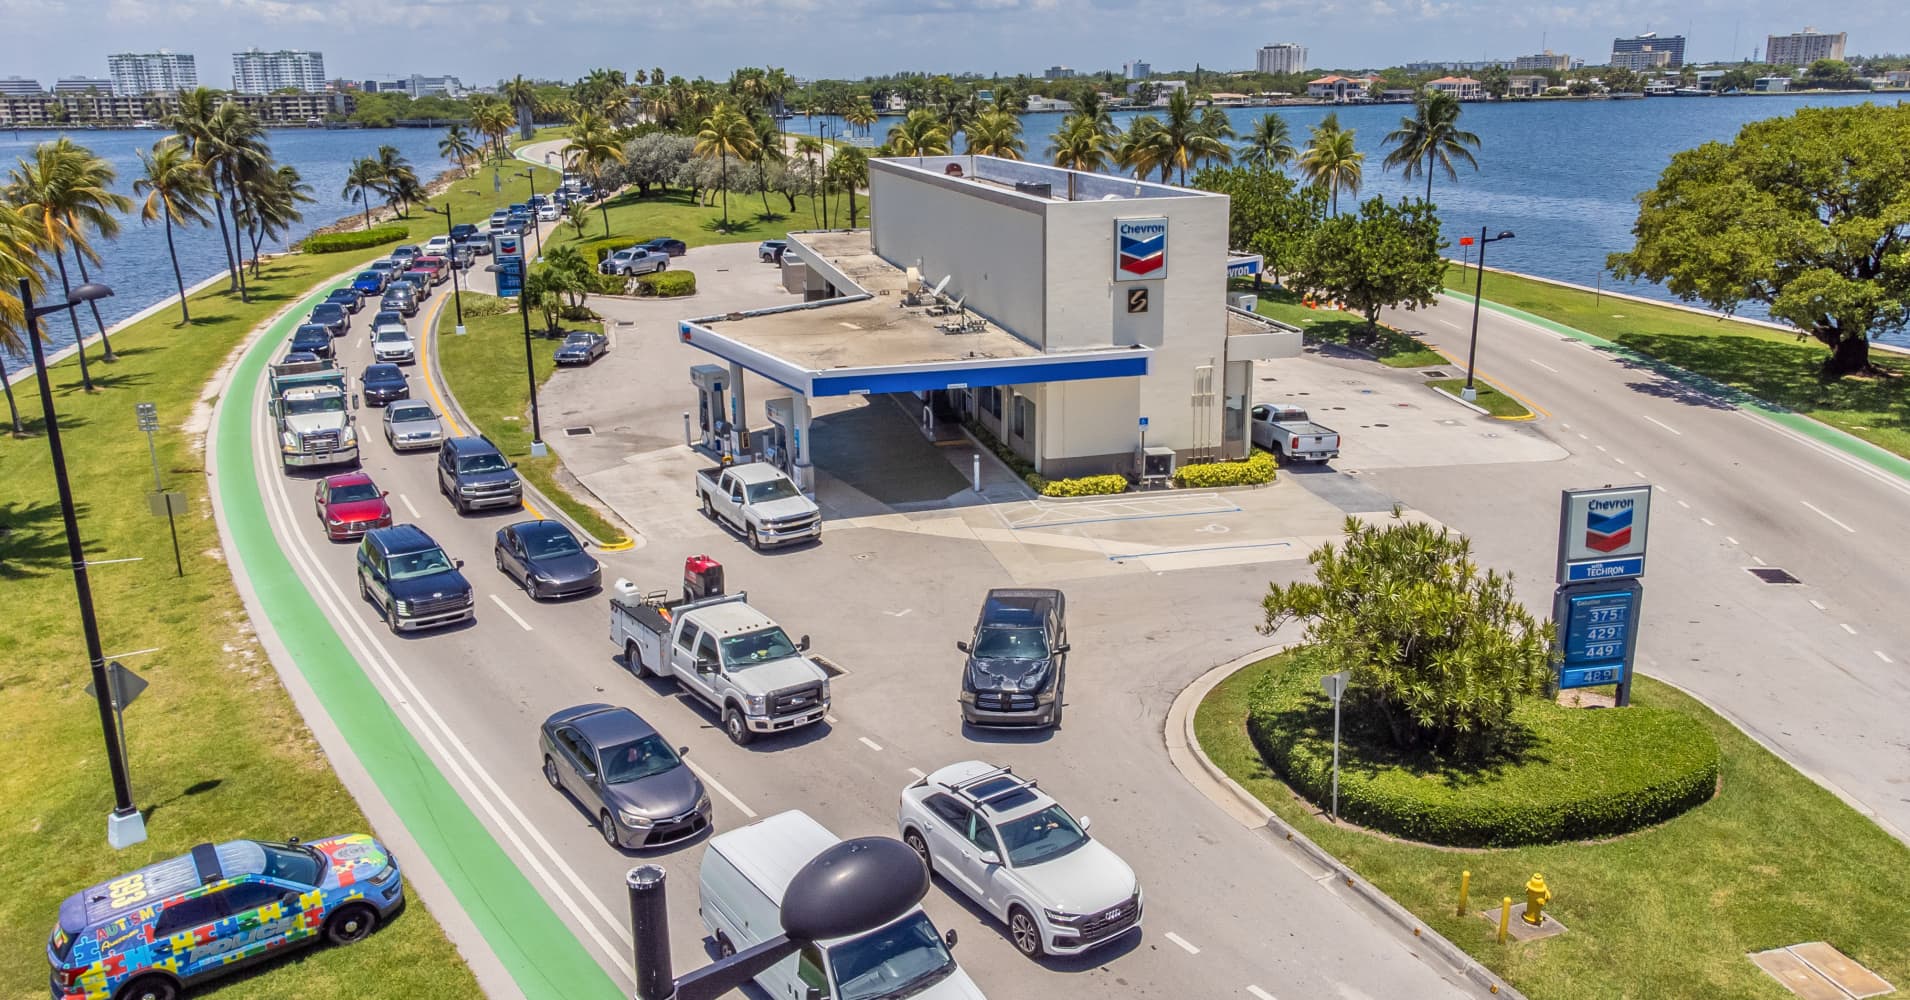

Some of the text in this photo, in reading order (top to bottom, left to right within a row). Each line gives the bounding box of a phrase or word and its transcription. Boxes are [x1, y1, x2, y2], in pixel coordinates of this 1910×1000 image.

[1120, 223, 1165, 235] Chevron
[1588, 499, 1634, 511] Chevron
[1587, 566, 1625, 577] TECHRON
[1591, 609, 1618, 622] 375
[1587, 627, 1616, 640] 429
[1586, 645, 1614, 657] 449
[96, 906, 156, 941] AUTISM
[190, 916, 294, 962] POLICE
